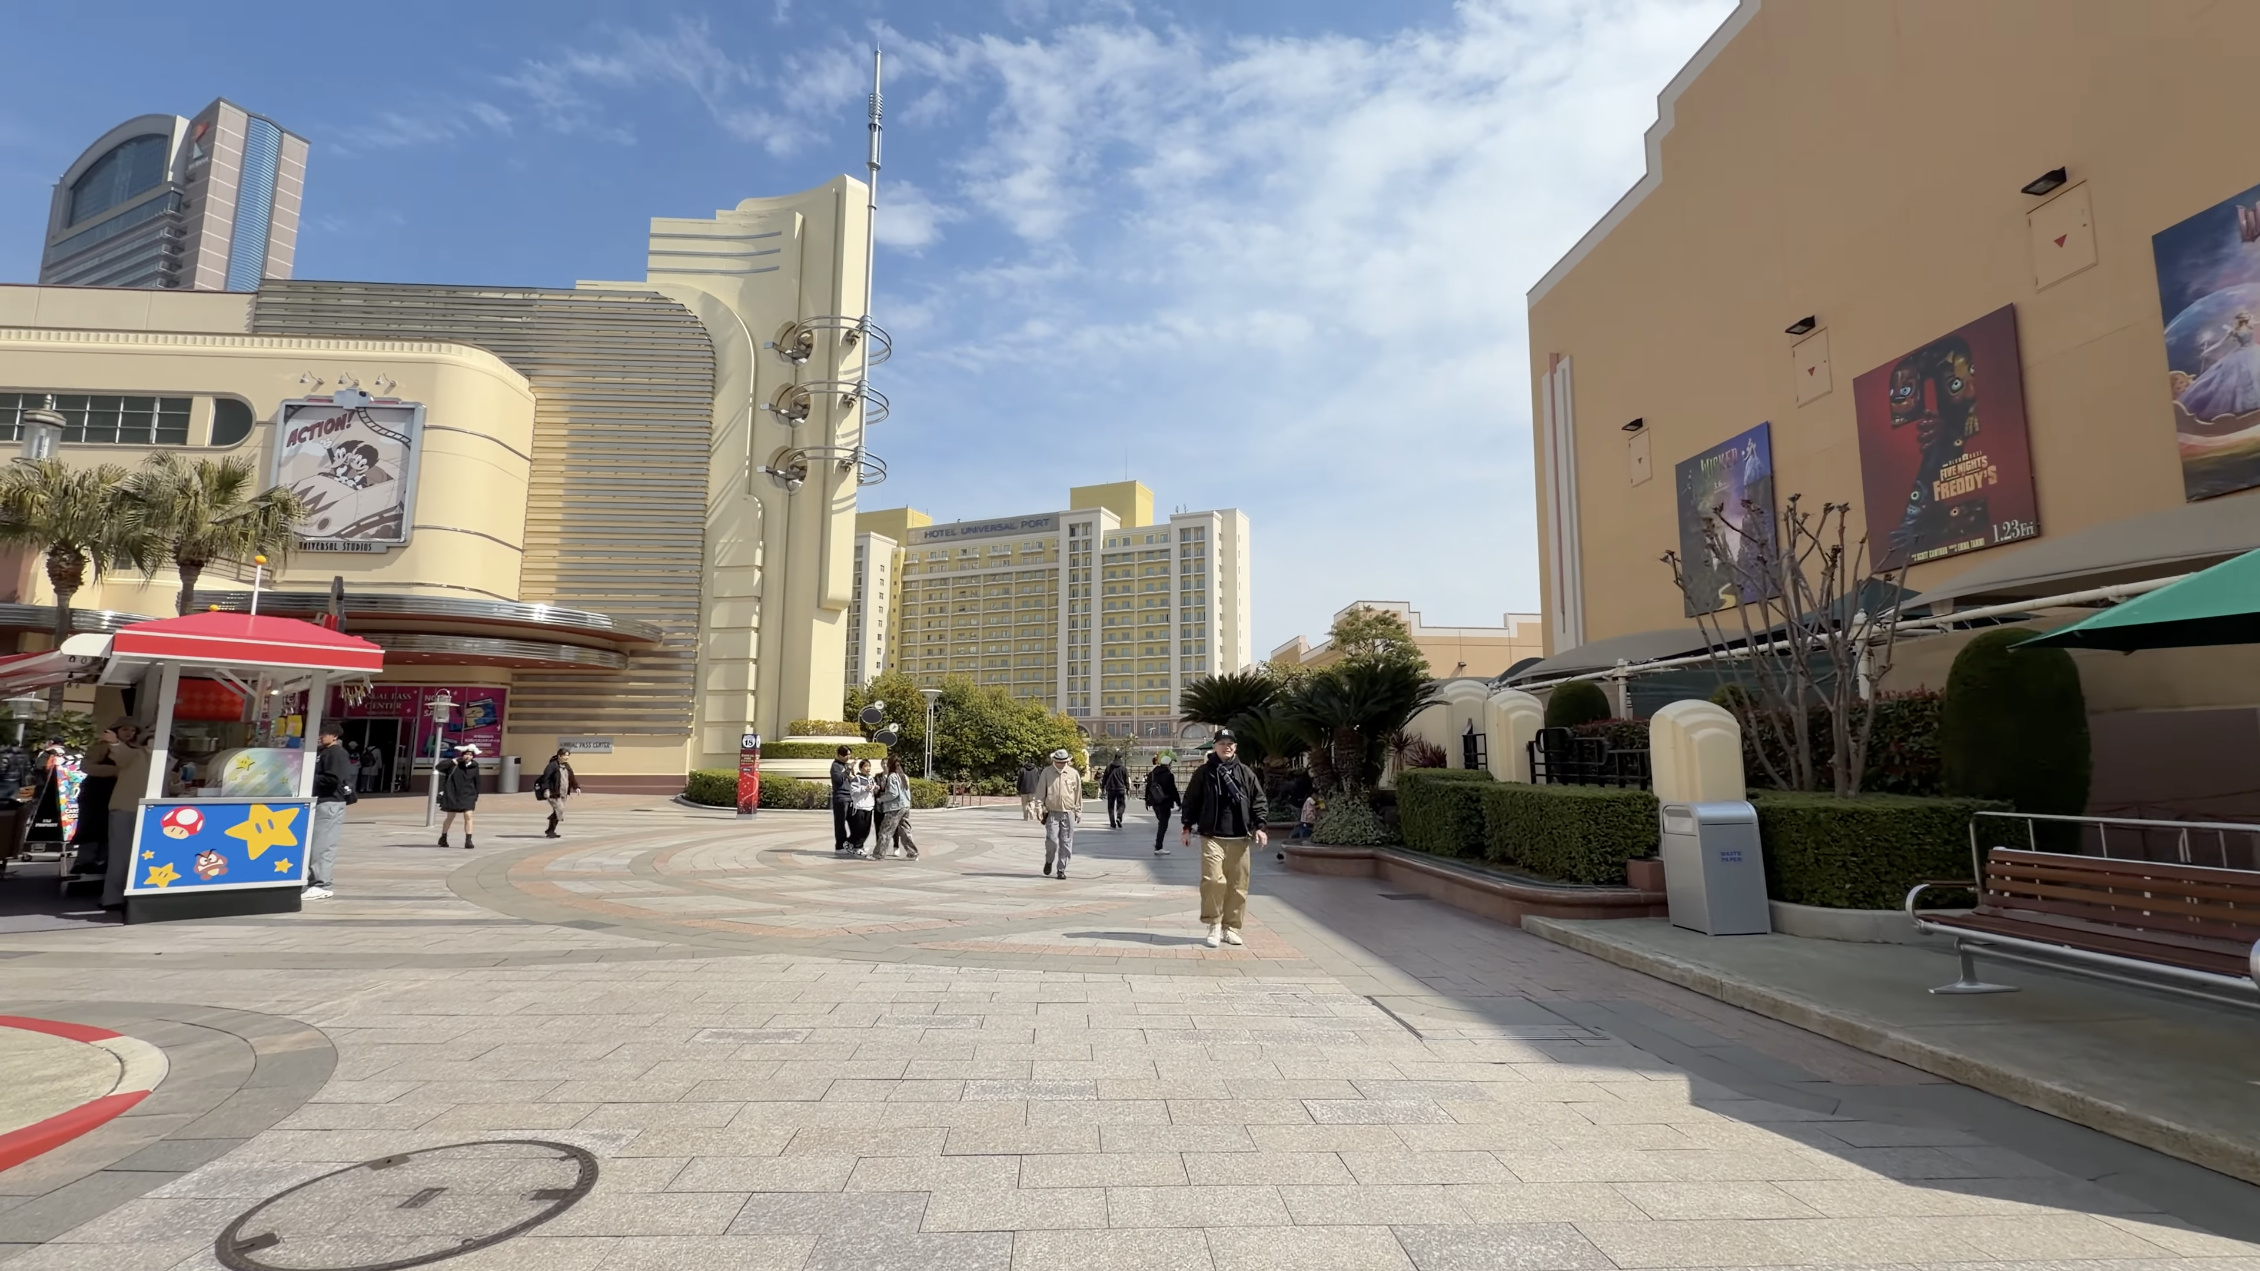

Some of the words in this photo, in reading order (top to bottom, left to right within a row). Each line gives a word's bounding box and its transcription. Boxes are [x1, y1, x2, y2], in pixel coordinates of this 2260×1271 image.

[286, 409, 356, 448] ACTION!
[1940, 465, 1957, 481] FIVE
[1957, 455, 1988, 475] NIGHTS
[1933, 465, 1998, 501] FREDDY'S
[924, 528, 957, 538] HOTEL
[961, 521, 1018, 535] UNIVERSAL
[1021, 518, 1050, 528] PORT
[342, 542, 372, 552] STUDIOS
